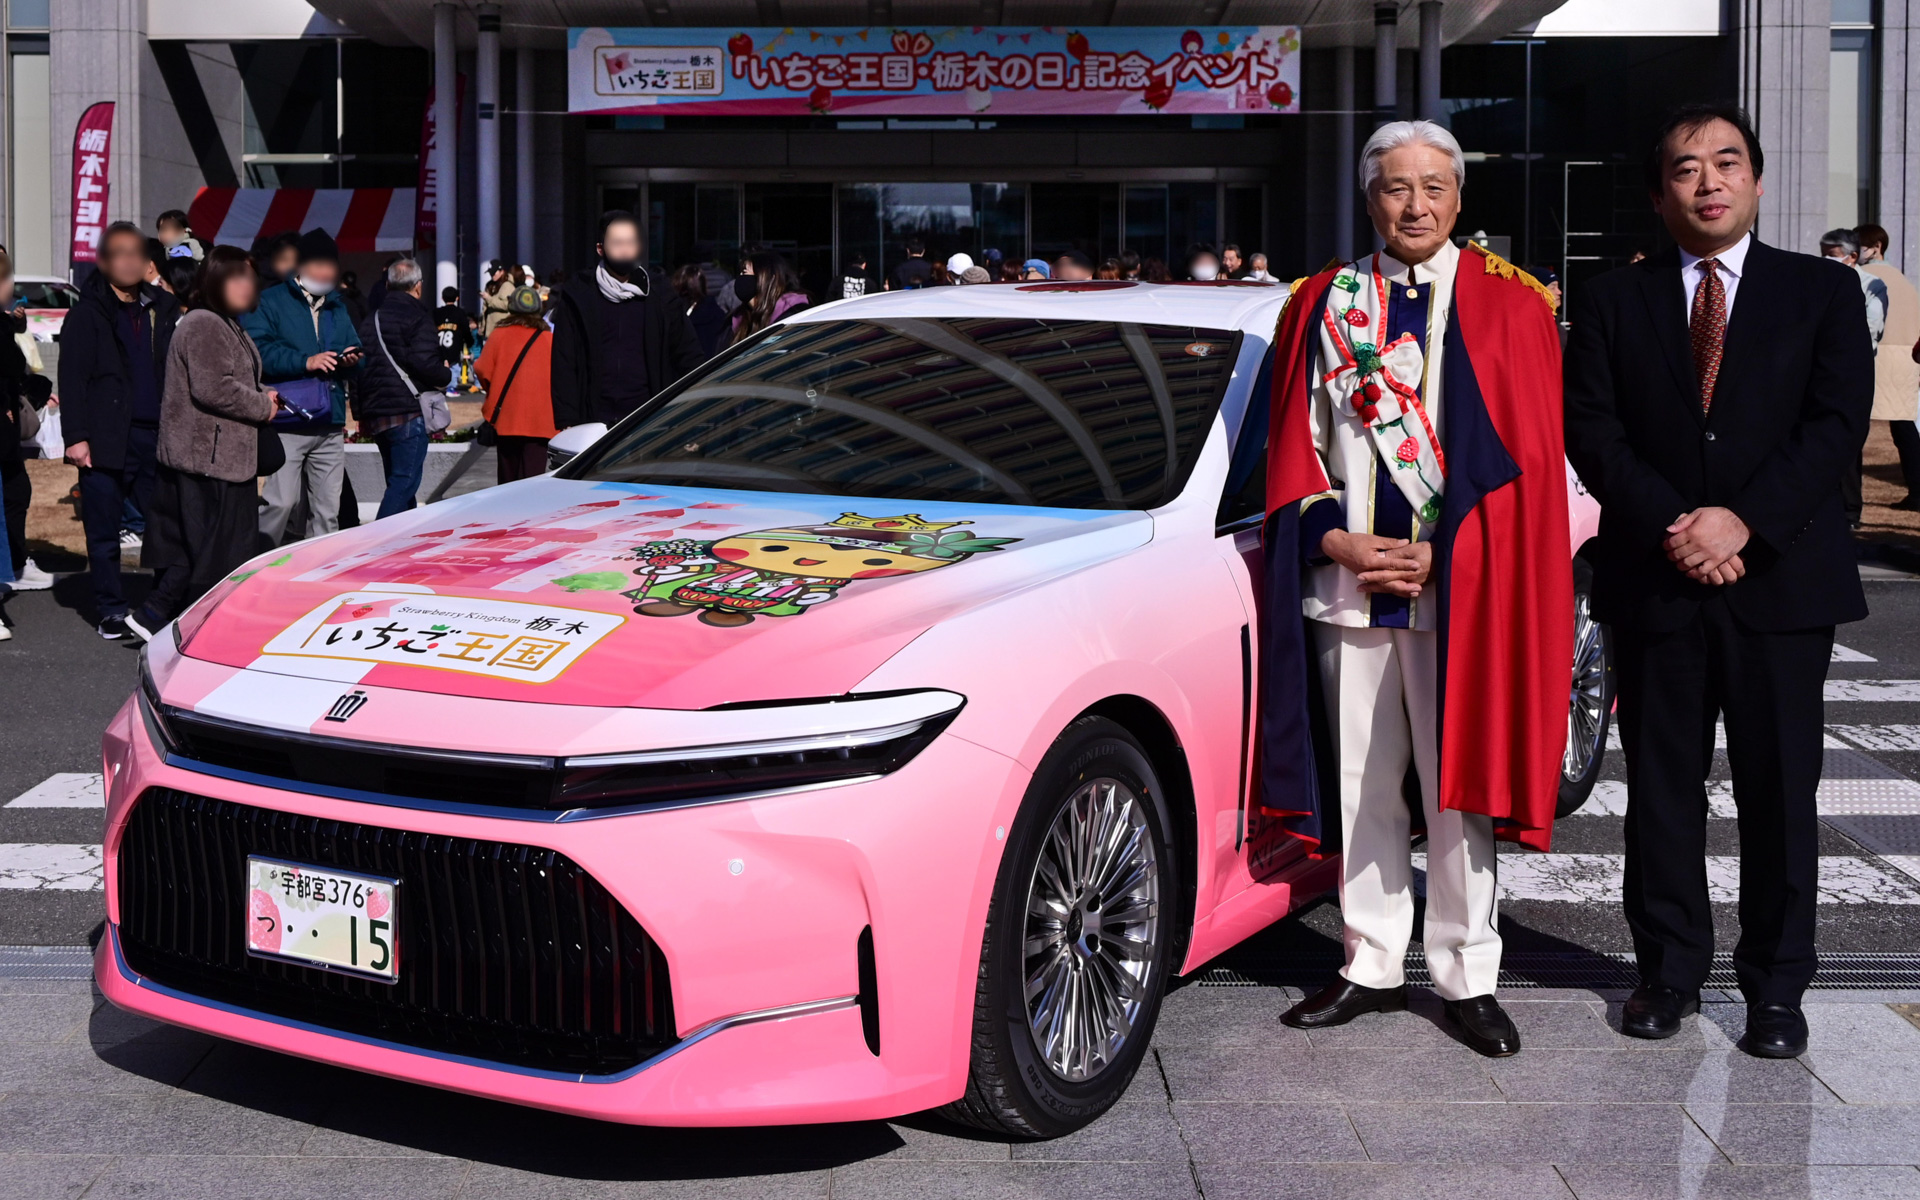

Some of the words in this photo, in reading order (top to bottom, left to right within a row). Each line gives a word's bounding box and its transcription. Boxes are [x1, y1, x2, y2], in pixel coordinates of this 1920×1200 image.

[690, 55, 715, 67] 栃木
[618, 69, 715, 90] いちご王国
[74, 128, 109, 249] 栃木トヨタ
[437, 330, 454, 348] 18
[398, 606, 464, 619] Strawberry
[464, 611, 521, 625] Kingdom
[525, 616, 589, 636] 栃木
[325, 621, 571, 672] いちご王国
[1068, 743, 1119, 775] DUNLOP
[257, 916, 276, 933] つ
